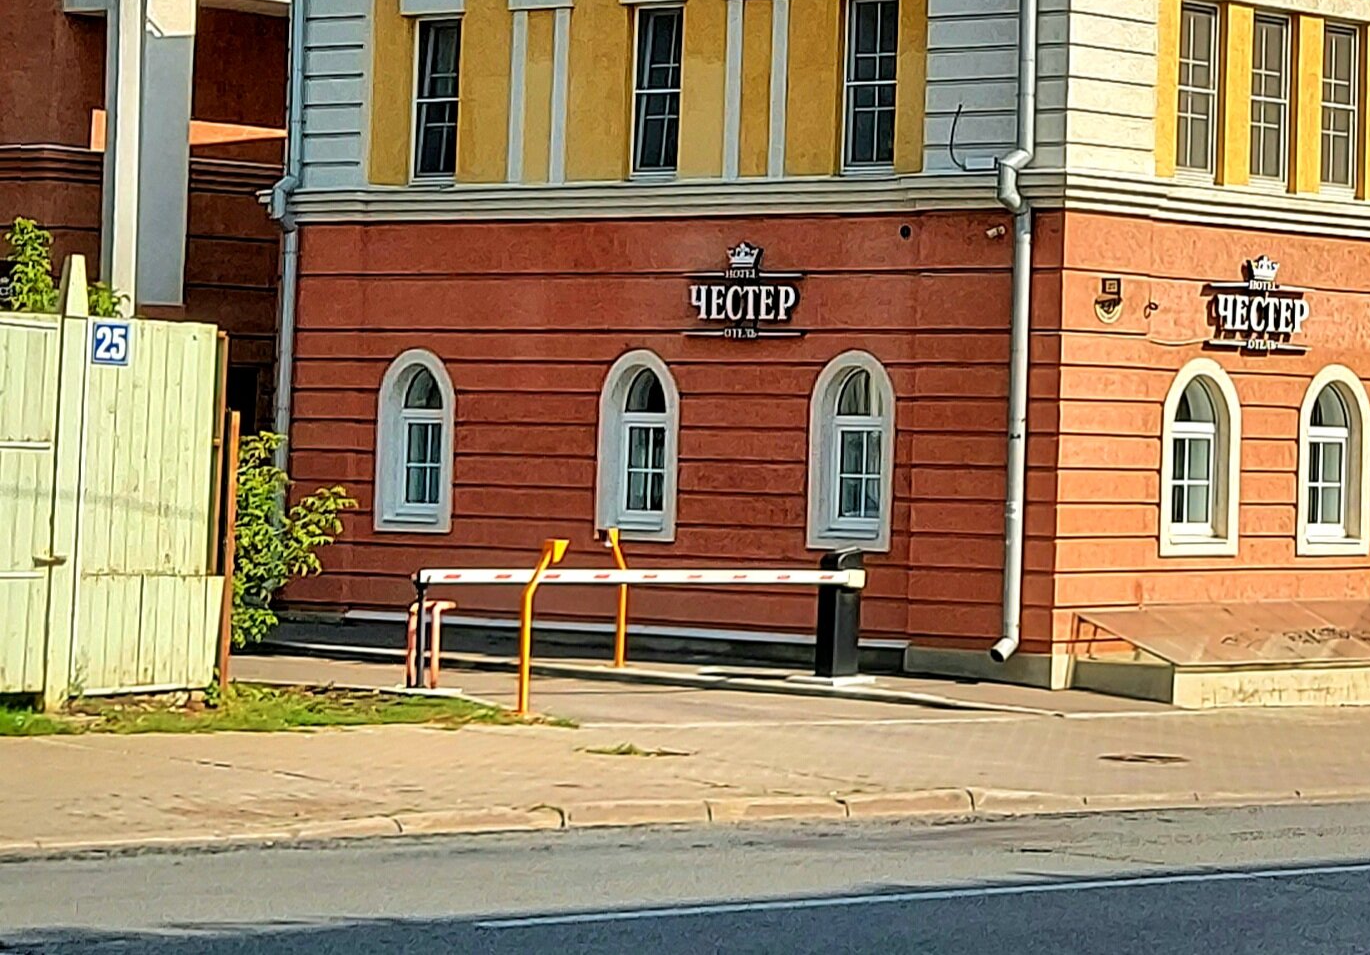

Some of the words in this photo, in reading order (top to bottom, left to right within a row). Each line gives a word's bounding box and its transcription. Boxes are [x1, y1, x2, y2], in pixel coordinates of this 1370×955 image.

[689, 285, 796, 320] ЧЕСТЕР
[1217, 294, 1310, 334] ЧЕСТЕР
[95, 326, 126, 360] 25
